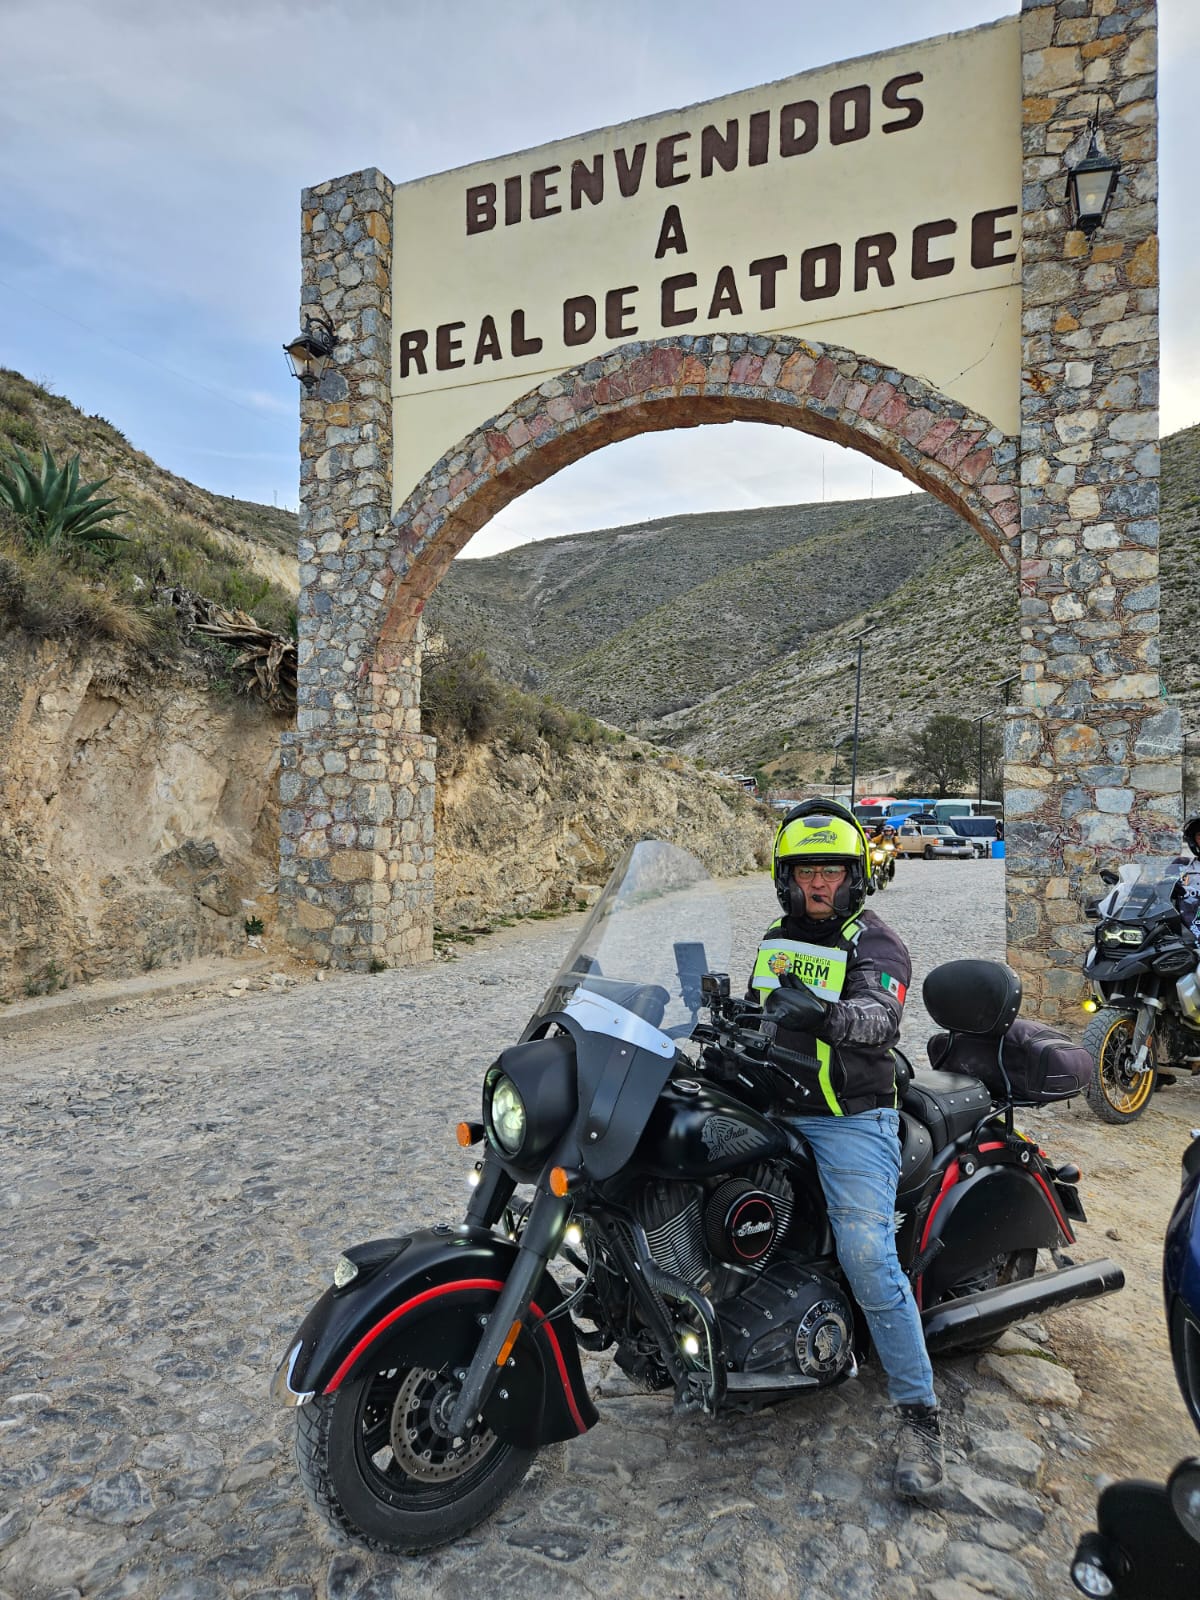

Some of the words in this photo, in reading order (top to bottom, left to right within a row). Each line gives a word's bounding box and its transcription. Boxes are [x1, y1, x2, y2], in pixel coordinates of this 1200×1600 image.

[465, 71, 924, 236] BIENVENIDOS
[654, 204, 688, 260] A
[399, 308, 543, 379] REAL
[562, 285, 639, 347] DE
[660, 204, 1019, 328] CATORCE
[792, 959, 830, 981] RRM
